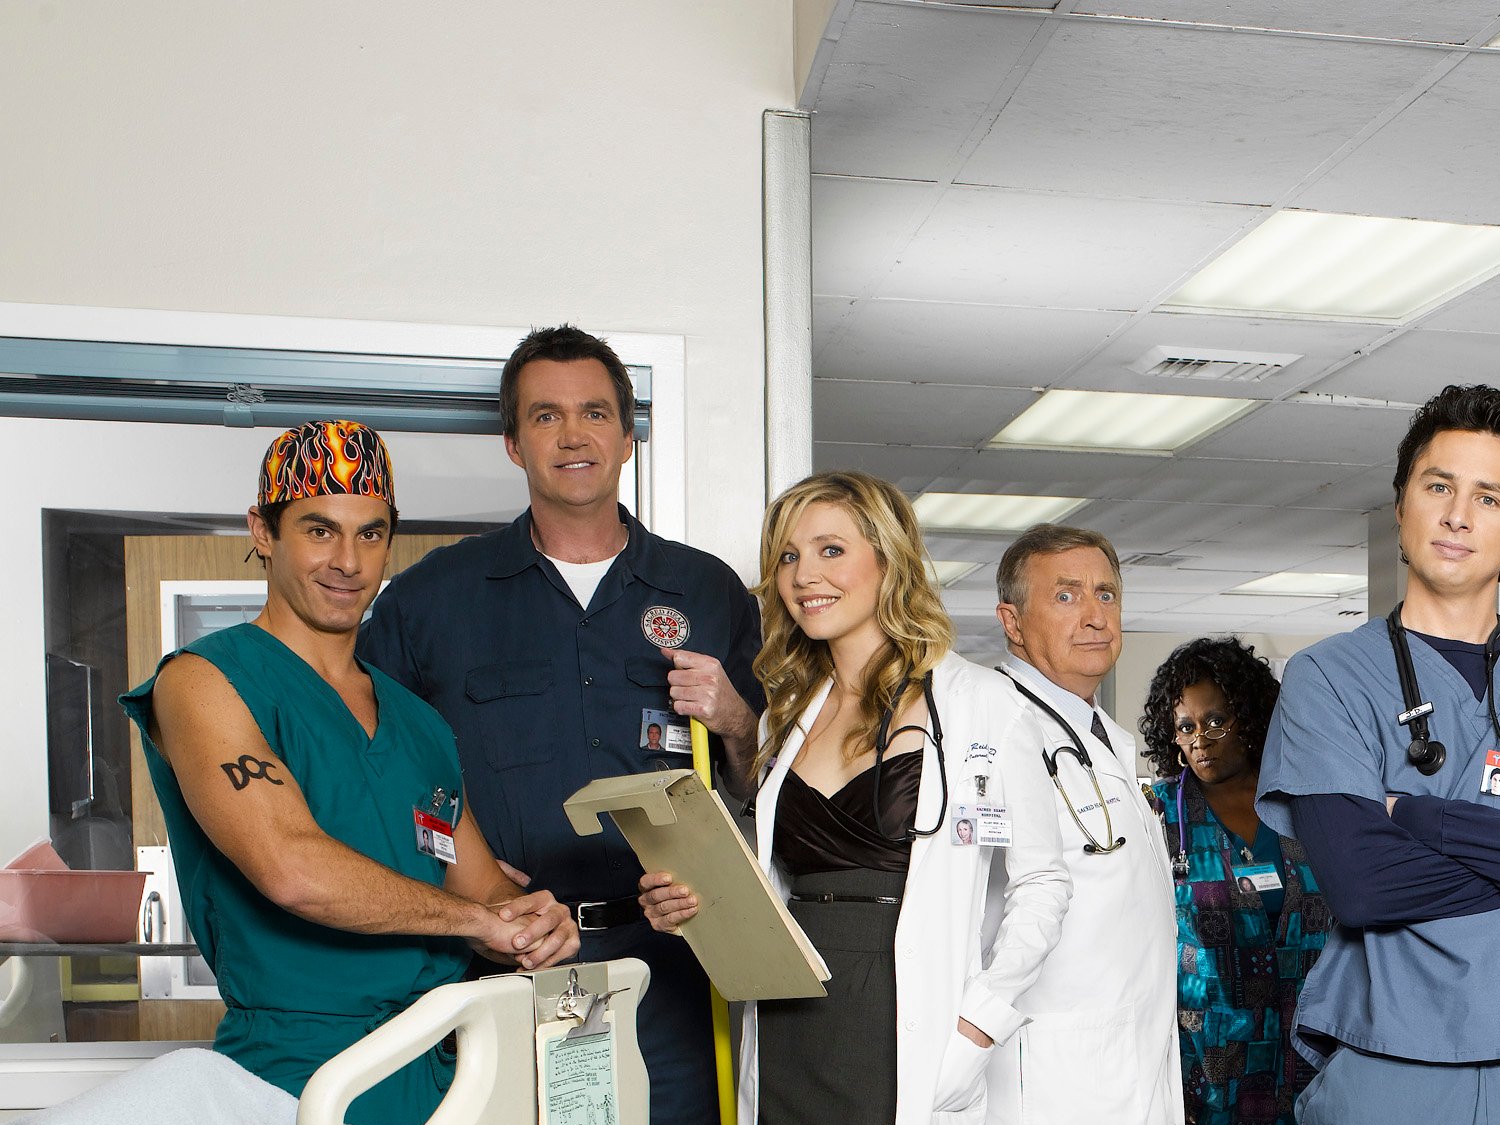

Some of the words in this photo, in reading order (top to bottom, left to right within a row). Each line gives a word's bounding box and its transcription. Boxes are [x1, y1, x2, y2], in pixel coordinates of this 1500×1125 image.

[645, 609, 665, 627] SACRED
[649, 633, 685, 646] HOSPITAL
[220, 754, 285, 791] DOC
[1077, 804, 1095, 815] SACRED
